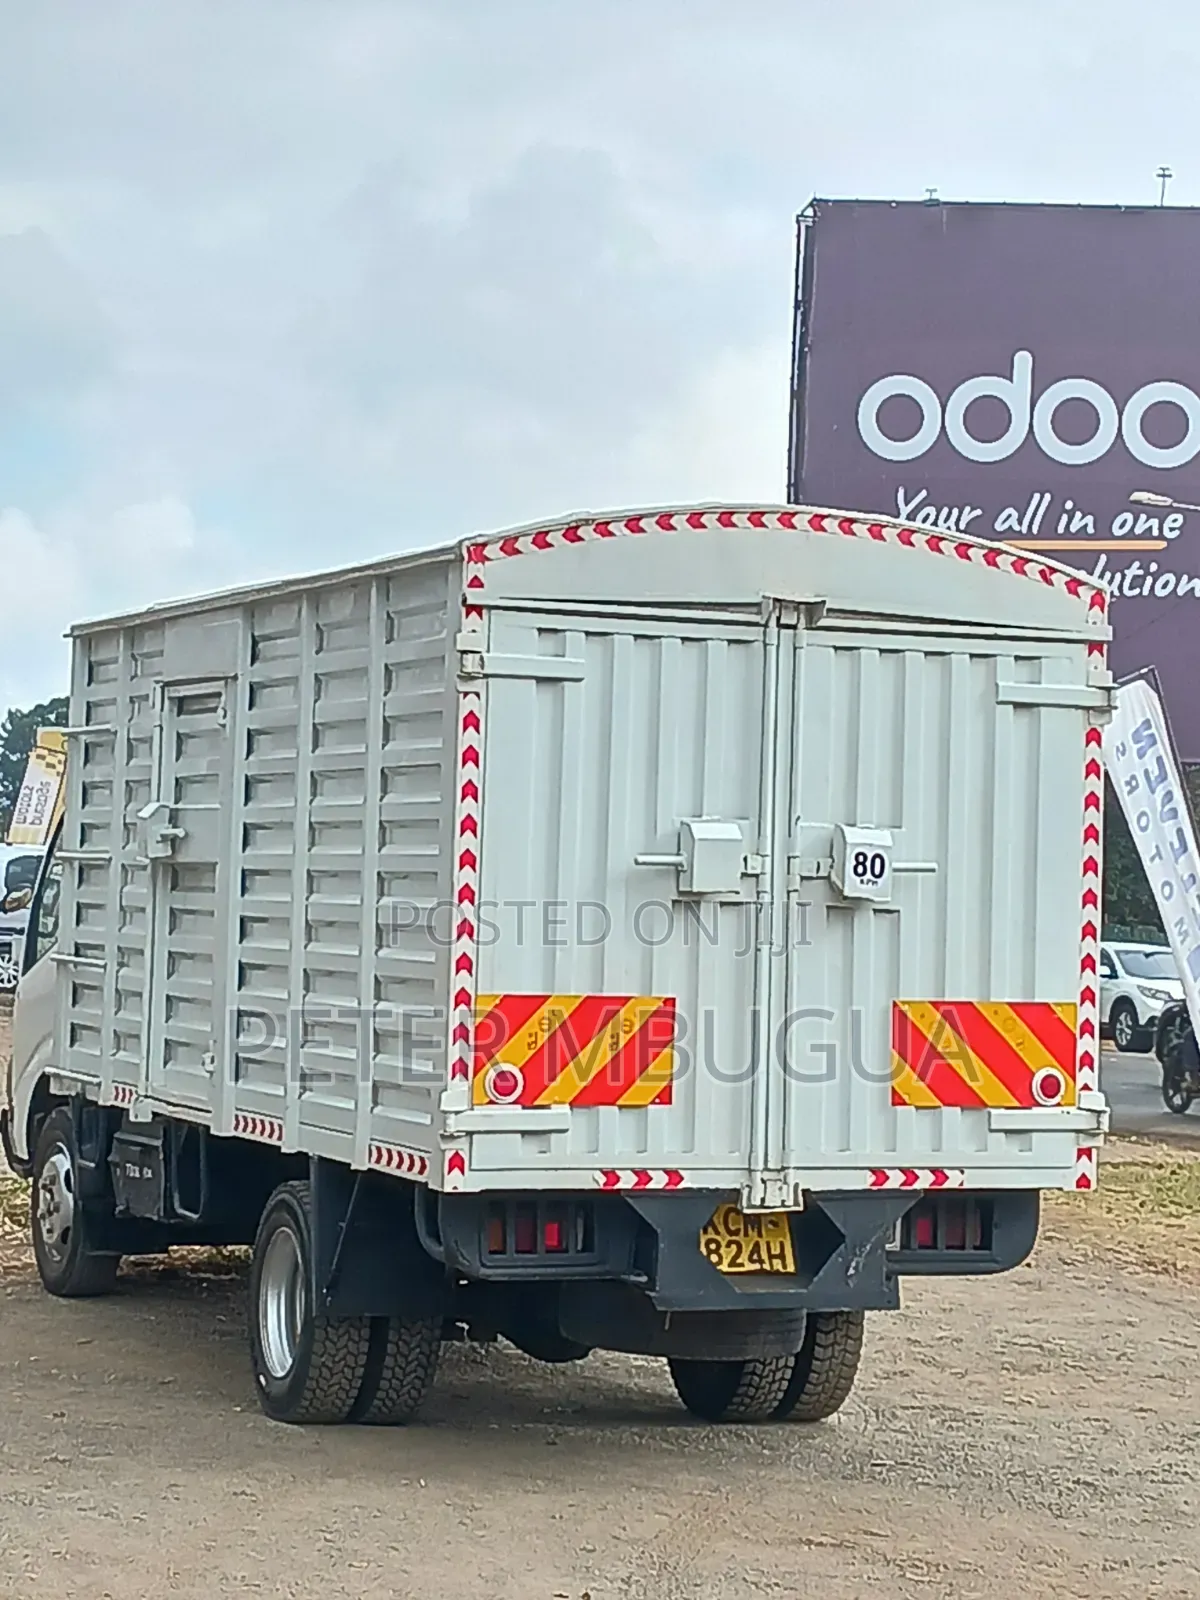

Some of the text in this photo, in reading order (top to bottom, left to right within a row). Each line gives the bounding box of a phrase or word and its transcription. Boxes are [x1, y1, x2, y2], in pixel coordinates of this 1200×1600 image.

[857, 350, 1200, 469] odoo
[896, 486, 1184, 540] Your all in one
[853, 851, 886, 879] 80
[704, 1238, 788, 1271] 824H
